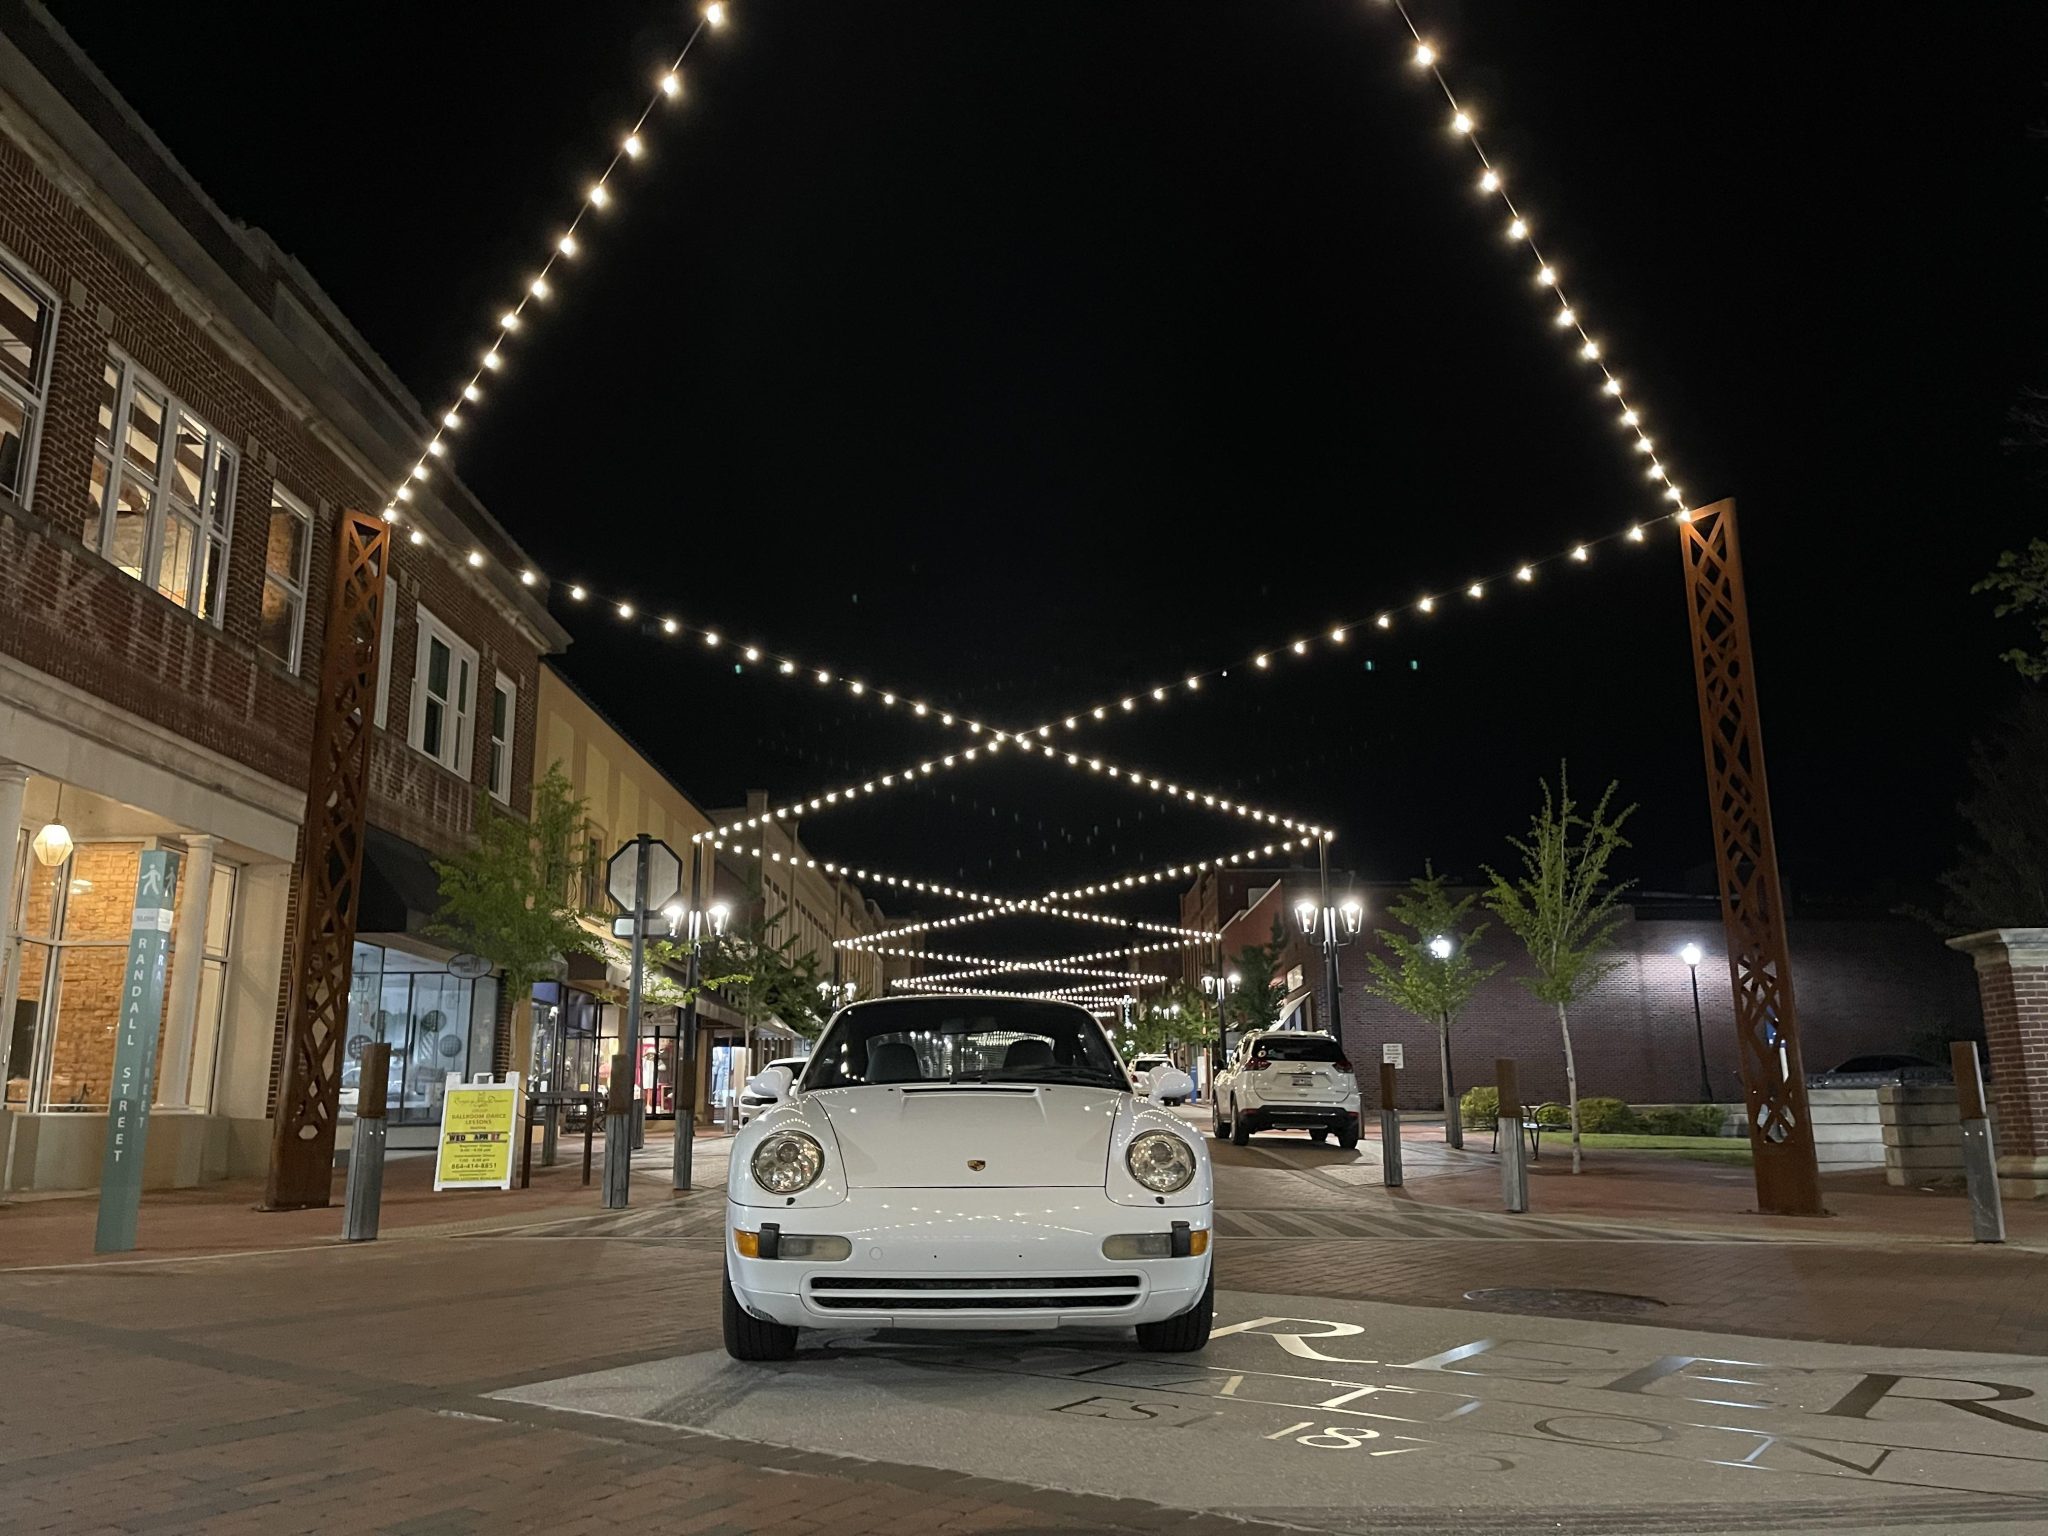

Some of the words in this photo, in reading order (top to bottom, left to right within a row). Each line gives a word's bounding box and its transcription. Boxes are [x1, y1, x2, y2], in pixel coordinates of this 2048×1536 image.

[126, 937, 148, 1046] RANDALL
[113, 1066, 132, 1163] STREET
[1206, 1315, 2048, 1434] REER
